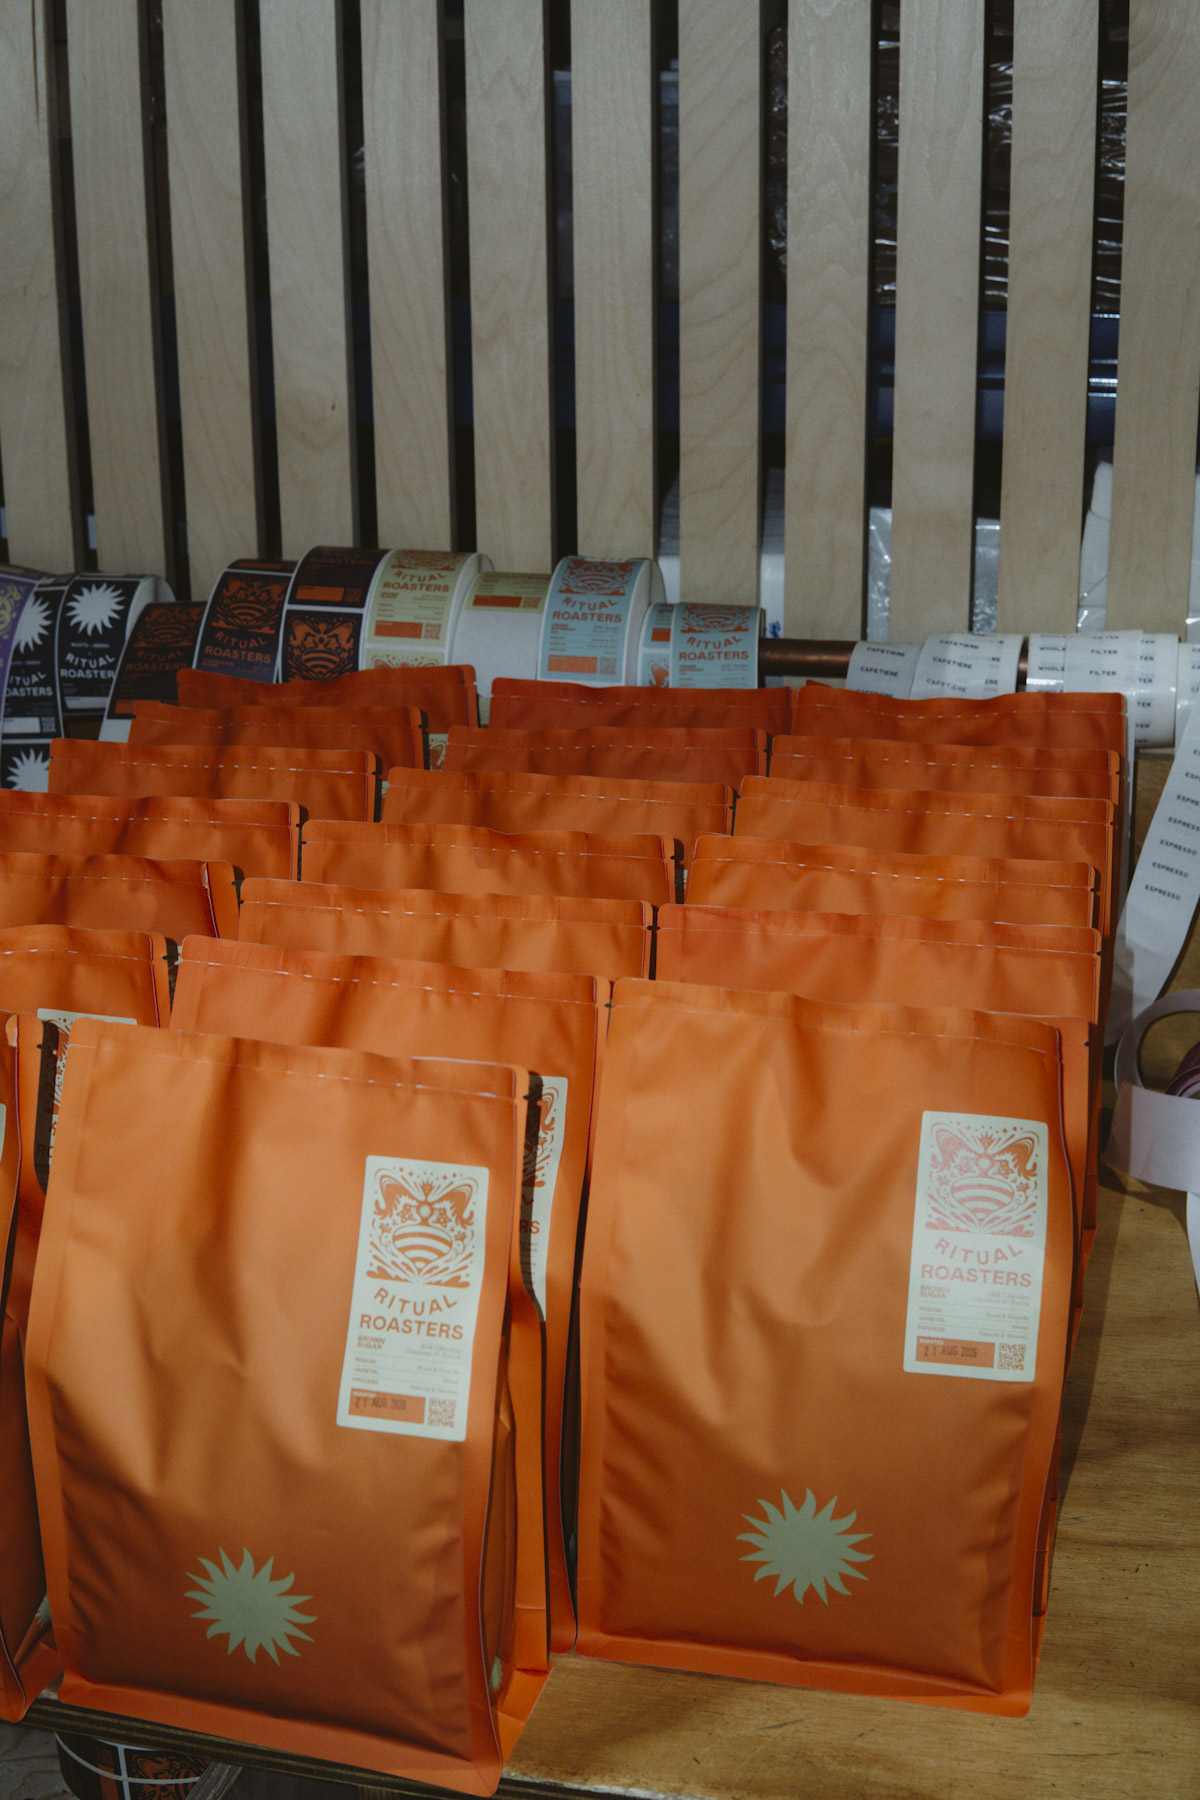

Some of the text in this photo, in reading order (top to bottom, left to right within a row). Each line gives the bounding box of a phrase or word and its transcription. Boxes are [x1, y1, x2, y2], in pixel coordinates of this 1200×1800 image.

[393, 570, 447, 582] RITUAL
[383, 581, 450, 593] ROASTERS
[562, 596, 618, 611] RITUAL
[552, 611, 622, 623] ROASTERS
[215, 631, 268, 648] RITUAL
[687, 636, 743, 649] RITUAL
[136, 649, 185, 662] RITUAL
[205, 646, 272, 664] ROASTERS
[679, 650, 749, 661] ROASTERS
[866, 646, 906, 658] CAFETIERE
[65, 652, 116, 669] RITUAL
[125, 662, 187, 671] ROASTERS
[932, 656, 973, 670] CAFETIERE
[60, 669, 115, 680] ROASTER
[860, 666, 899, 677] CAFETIERE
[9, 671, 46, 686] ITUAL
[6, 686, 53, 697] OASTERS
[1177, 794, 1200, 806] ESPRE
[1168, 816, 1200, 832] ESPRESS
[1160, 838, 1197, 856] ESPRESSO
[1152, 861, 1189, 878] ESPRESSO
[1144, 884, 1181, 901] ESPRESSO
[935, 1237, 1023, 1265] RITUAL
[920, 1264, 1032, 1287] ROASTERS
[374, 1287, 457, 1316] RITUAL
[359, 1313, 463, 1340] ROASTERS
[358, 1335, 385, 1344] BROWN
[941, 1345, 958, 1356] AUG
